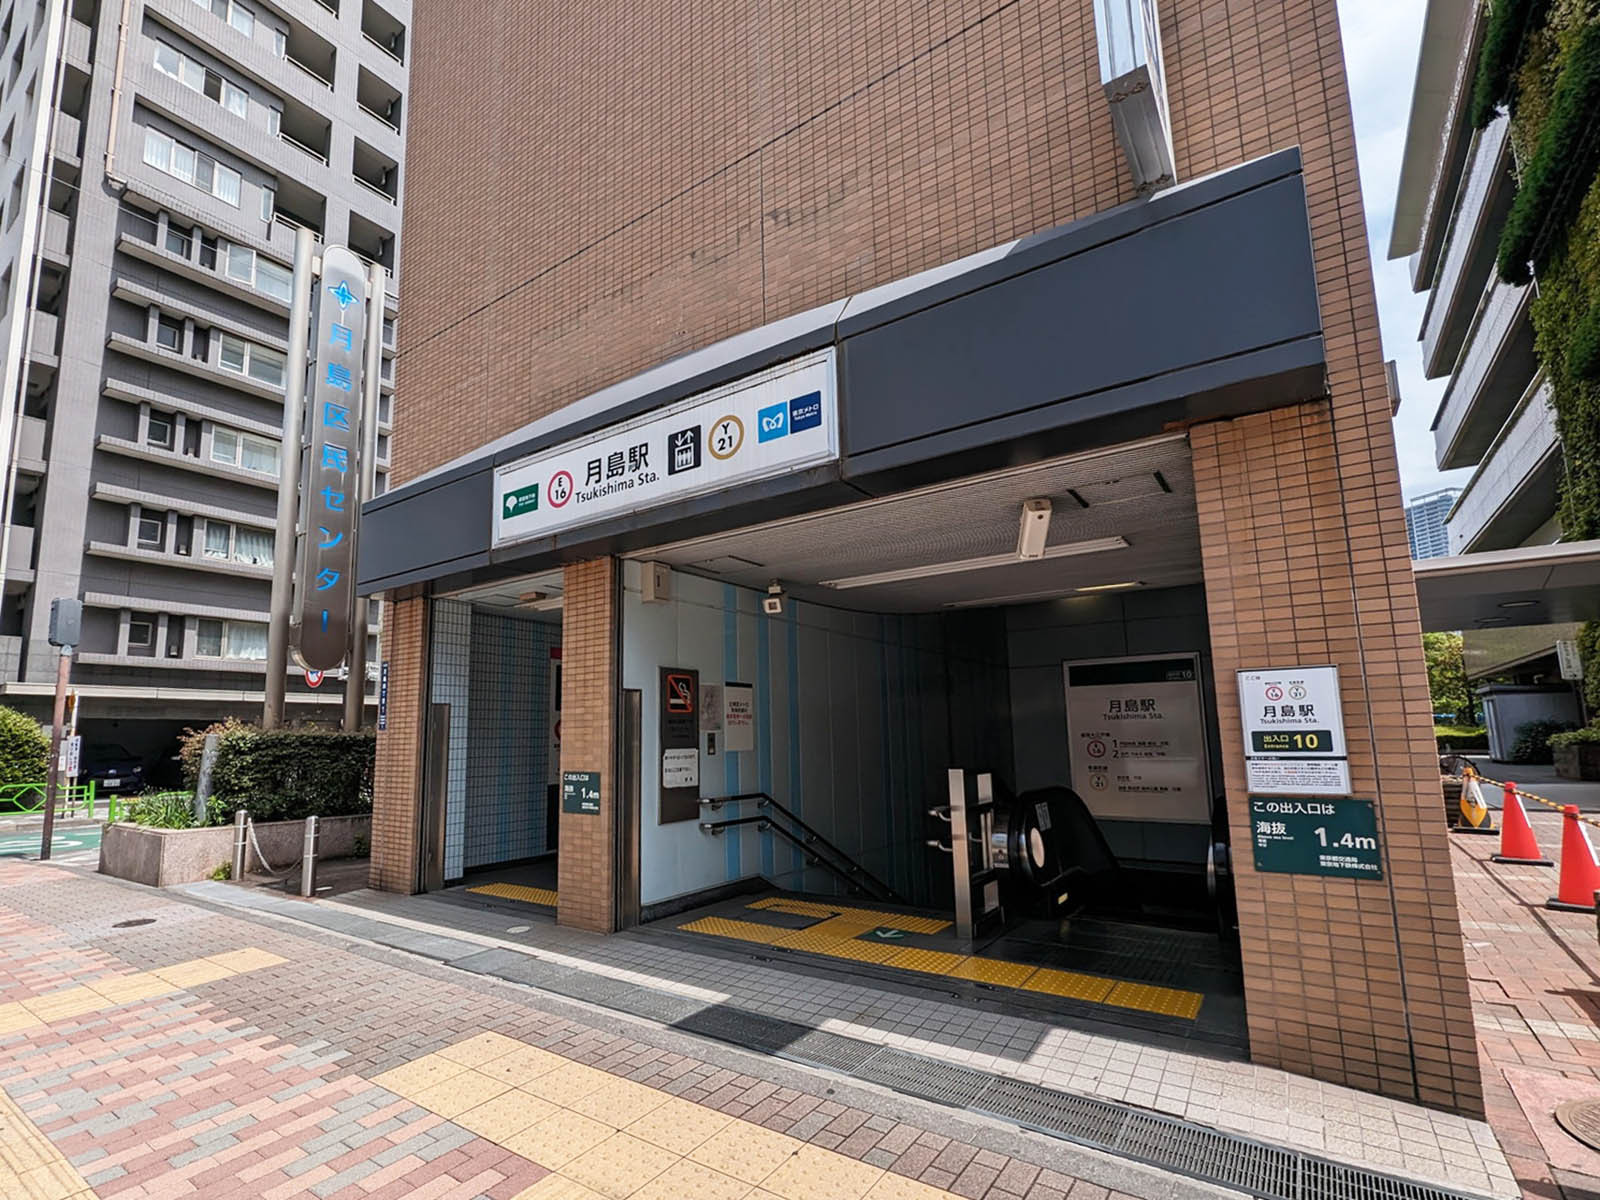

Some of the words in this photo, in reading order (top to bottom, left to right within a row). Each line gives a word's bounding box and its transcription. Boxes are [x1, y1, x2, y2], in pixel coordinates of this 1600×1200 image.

[722, 422, 730, 436] Y
[717, 435, 733, 451] 21
[585, 443, 650, 486] 月島駅
[316, 322, 353, 632] 月島区民センター
[557, 477, 564, 487] E
[554, 487, 567, 500] 16
[575, 478, 635, 504] Tsukishima
[637, 470, 660, 487] Sta.
[1109, 699, 1156, 713] 月島駅
[1263, 704, 1315, 718] 月島駅
[1103, 713, 1147, 721] Tsukishima
[1260, 717, 1303, 725] Tsukishima
[1263, 734, 1289, 743] 出入口
[1293, 733, 1318, 749] 10
[1253, 801, 1336, 815] この出入口は
[1256, 821, 1287, 835] 海抜
[1314, 827, 1377, 850] 1.4m
